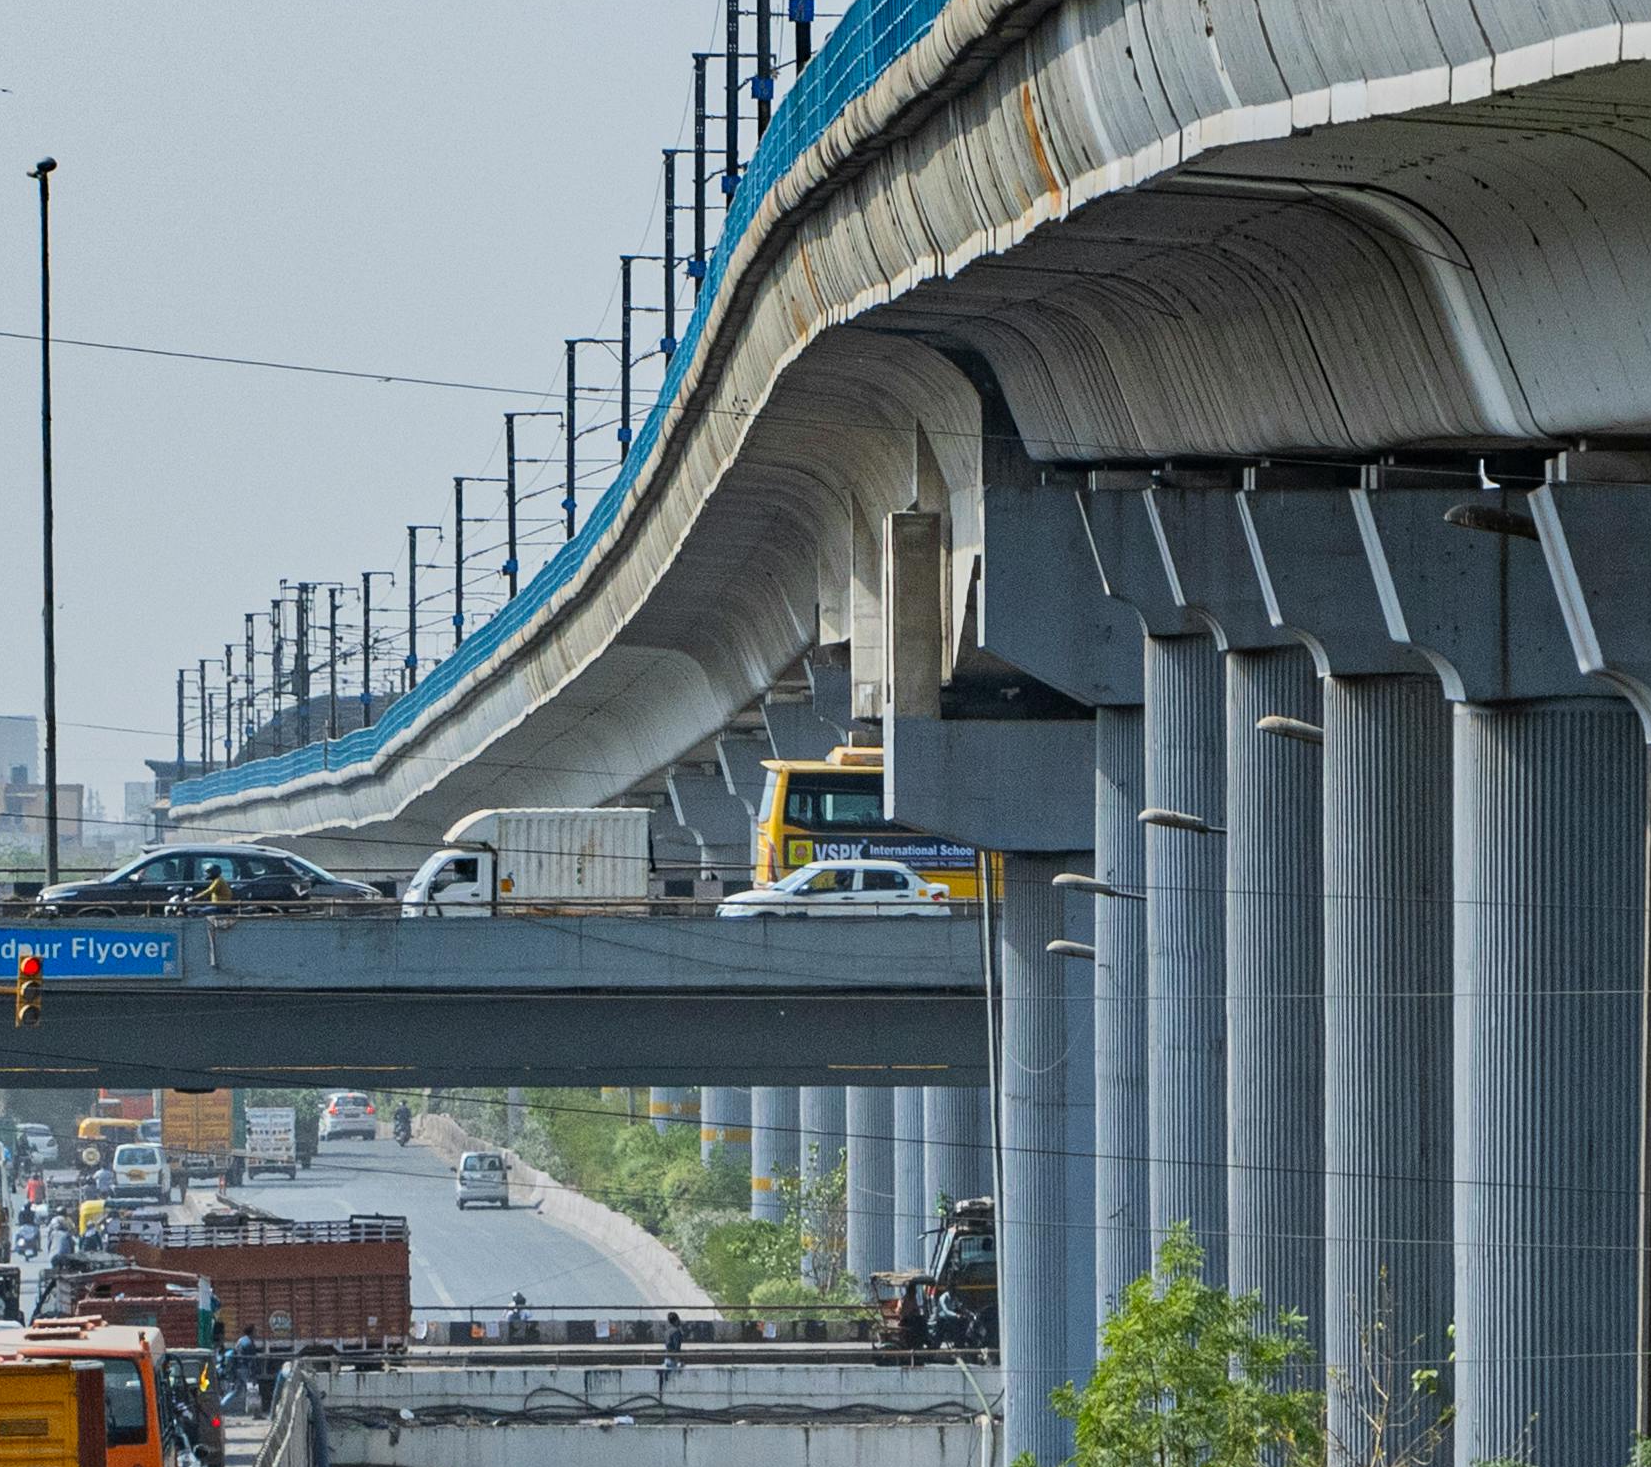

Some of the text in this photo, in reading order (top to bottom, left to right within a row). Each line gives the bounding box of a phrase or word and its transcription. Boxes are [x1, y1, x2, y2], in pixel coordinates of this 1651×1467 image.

[815, 844, 863, 861] VSPK
[870, 844, 937, 857] International
[71, 937, 171, 964] Flyover
